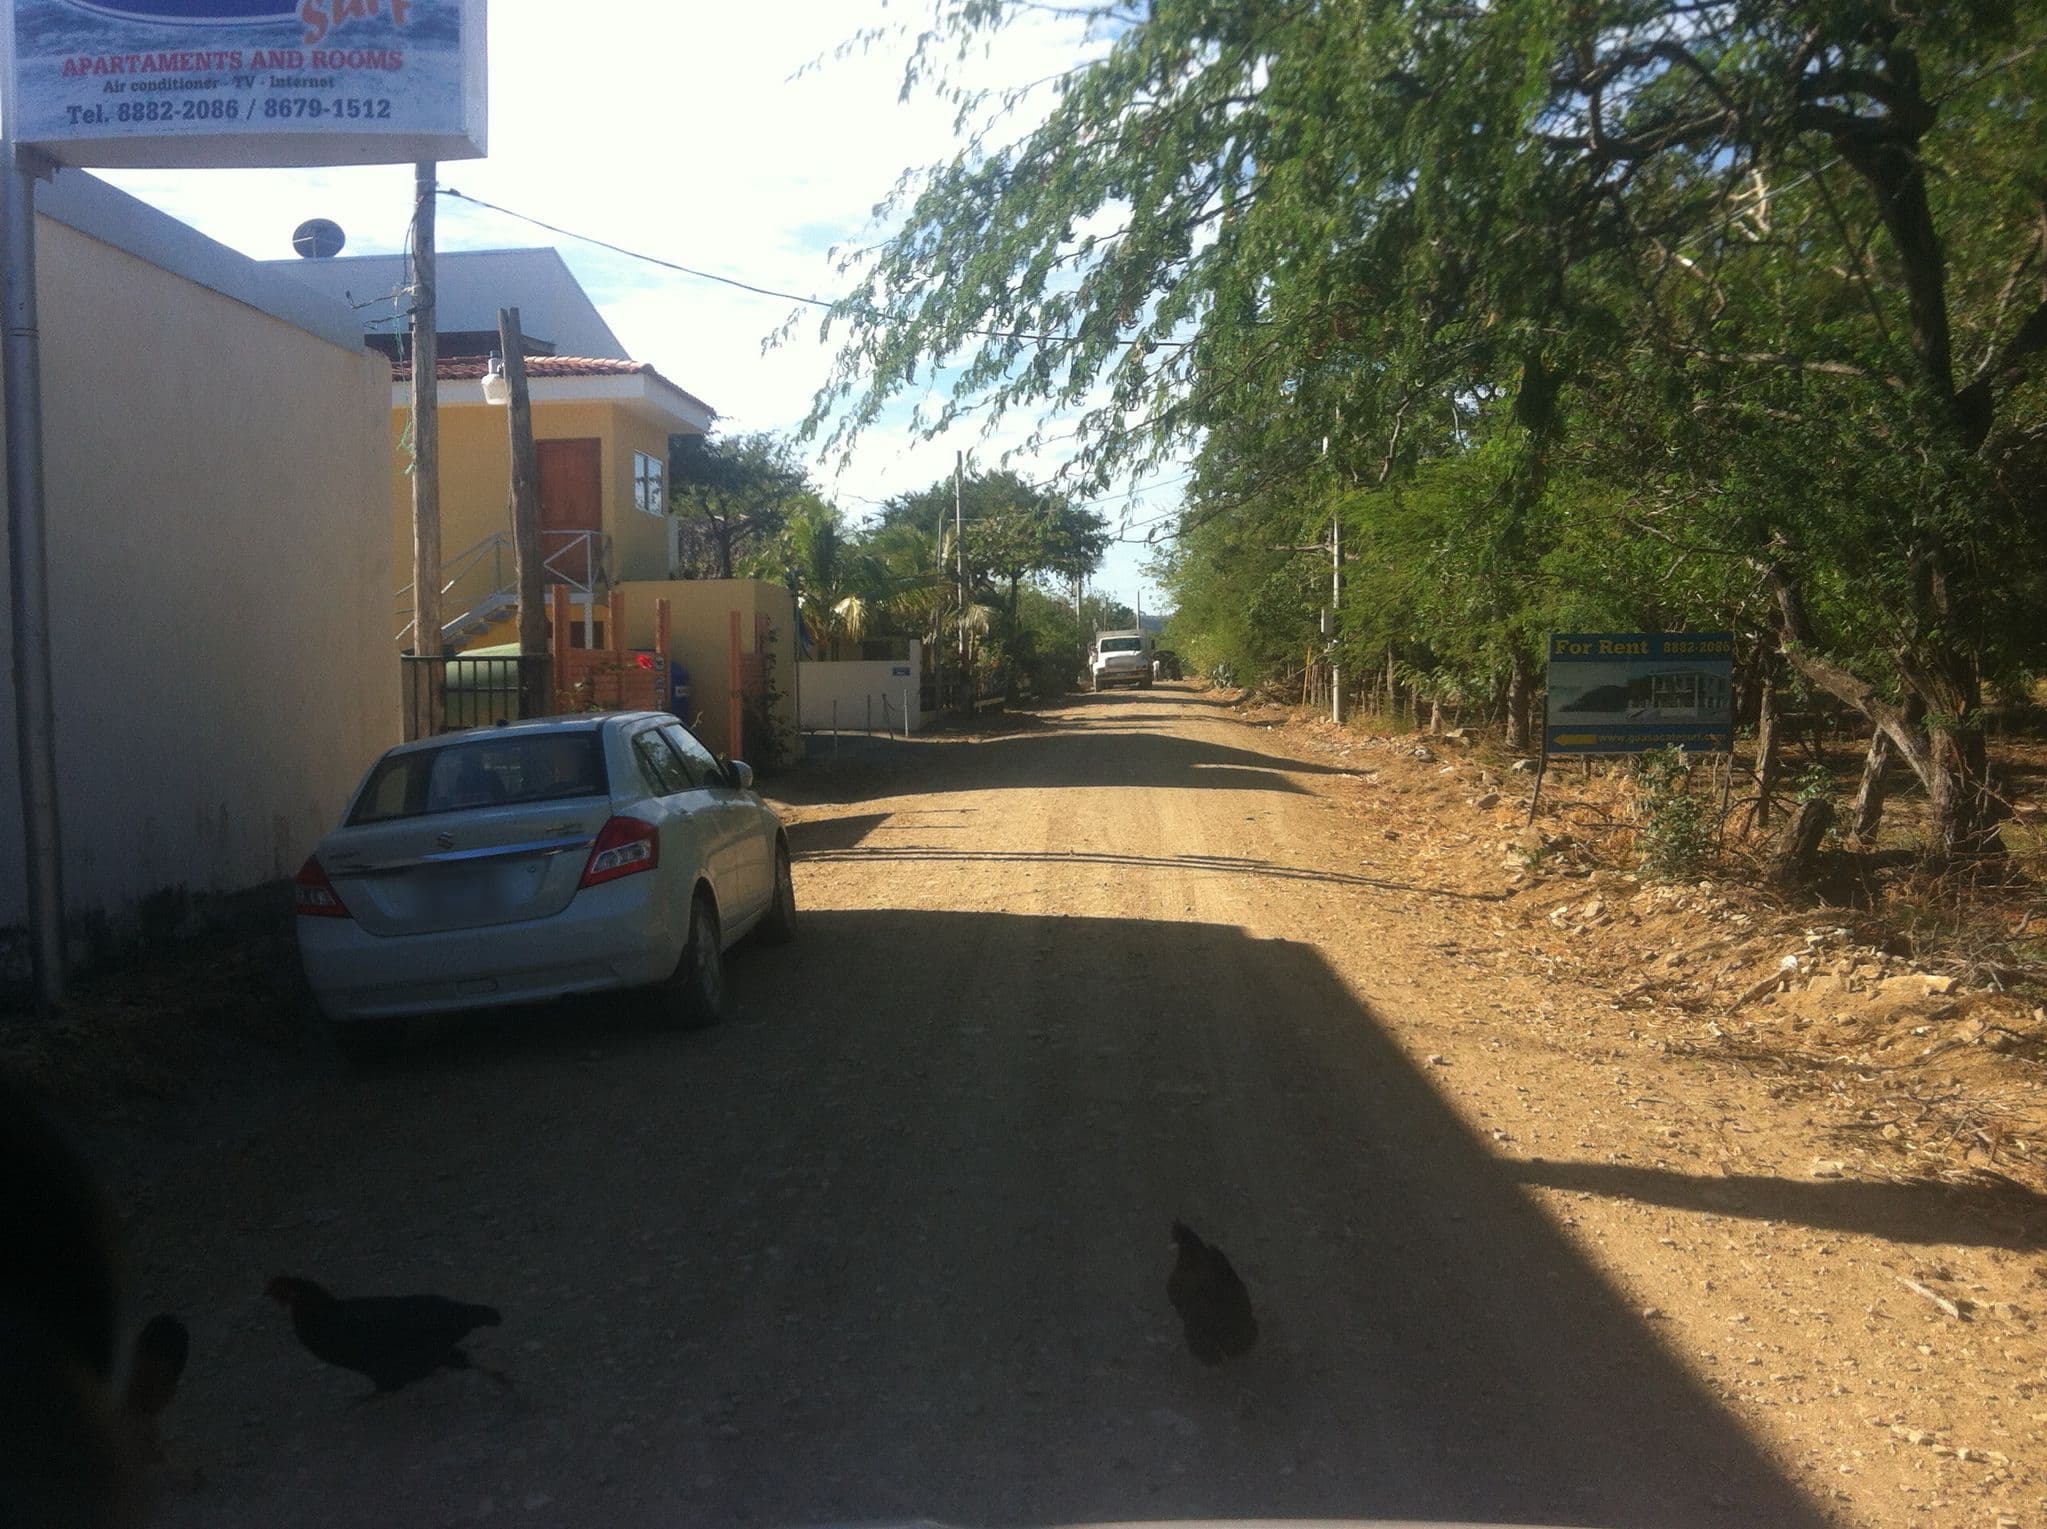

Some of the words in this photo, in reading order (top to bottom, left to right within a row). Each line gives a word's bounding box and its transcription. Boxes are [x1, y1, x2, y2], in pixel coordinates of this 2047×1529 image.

[62, 51, 242, 77] APARTAMENTS
[251, 51, 304, 70] AND
[311, 51, 402, 71] ROOMS
[103, 80, 127, 93] Air
[130, 77, 219, 92] conditioner
[232, 75, 255, 89] TV
[269, 75, 336, 88] Internet
[66, 104, 110, 125] Tel.
[117, 99, 240, 122] 8882-2086
[264, 98, 391, 118] 8679-1512
[1555, 640, 1593, 655] For
[1599, 640, 1649, 655] Rent
